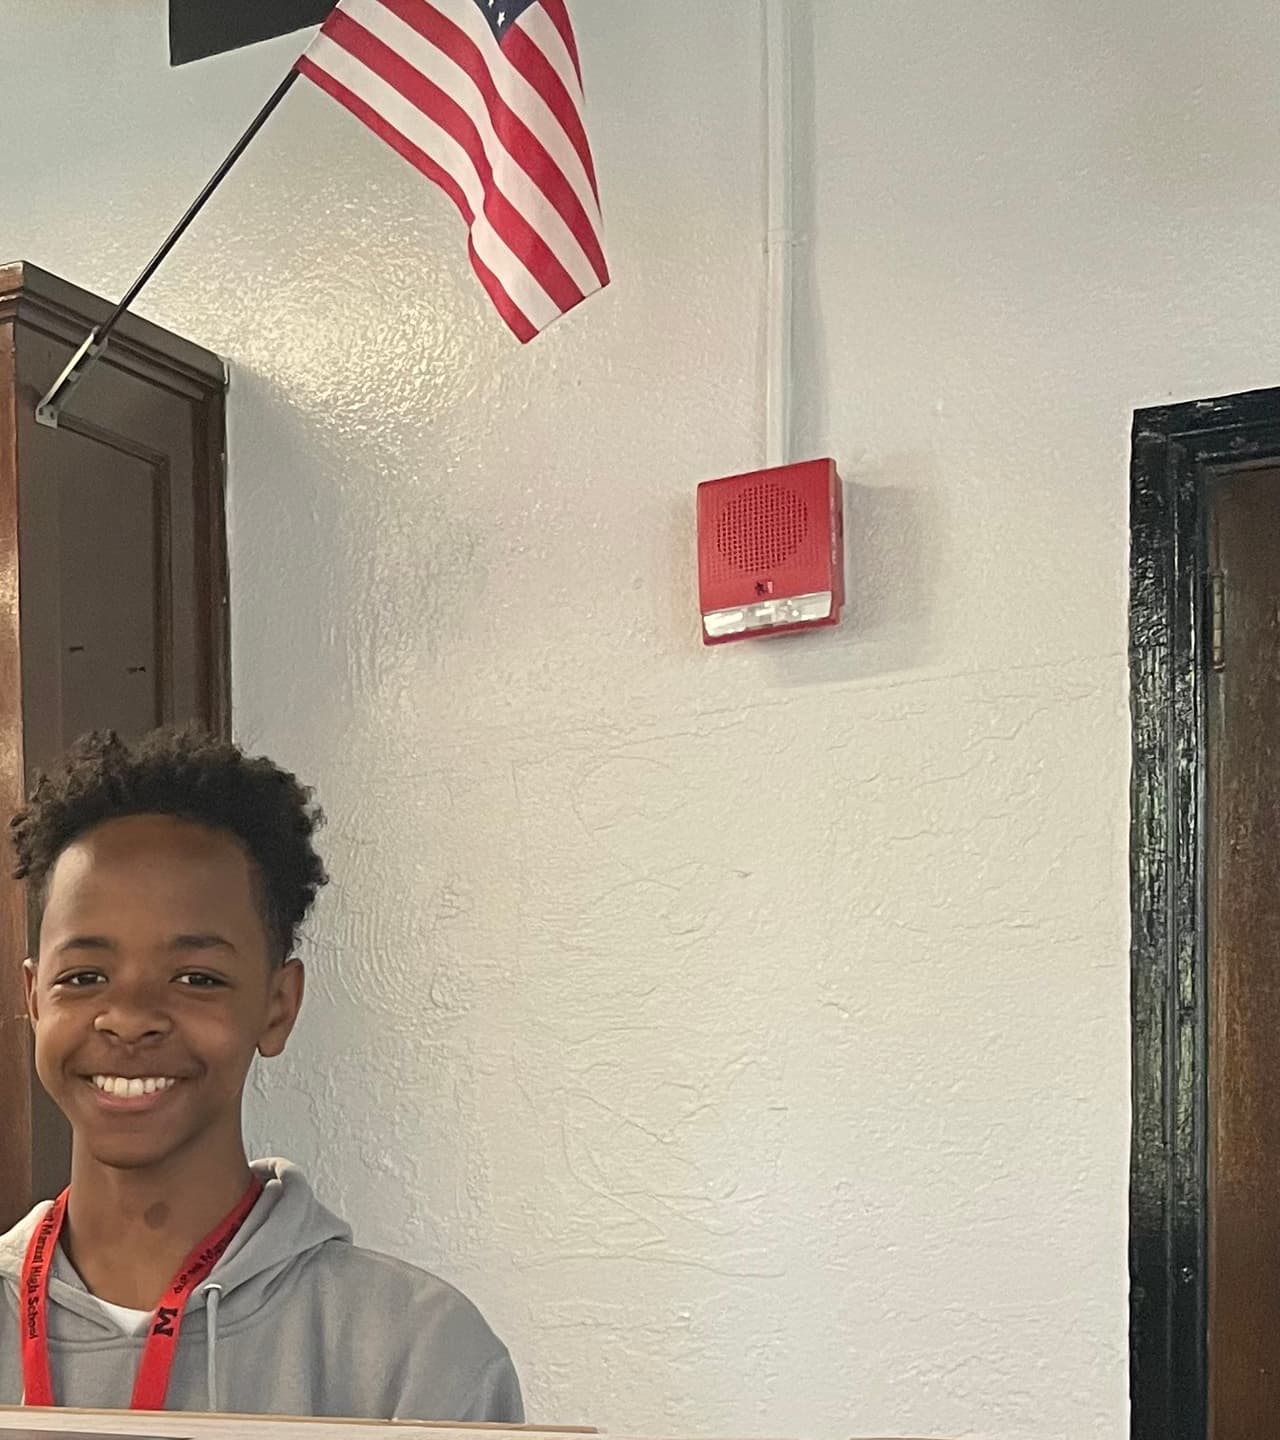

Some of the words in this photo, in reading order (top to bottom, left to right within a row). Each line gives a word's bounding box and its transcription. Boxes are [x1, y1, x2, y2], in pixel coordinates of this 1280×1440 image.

[27, 1265, 43, 1294] High
[27, 1297, 40, 1339] School
[152, 1307, 179, 1338] M
